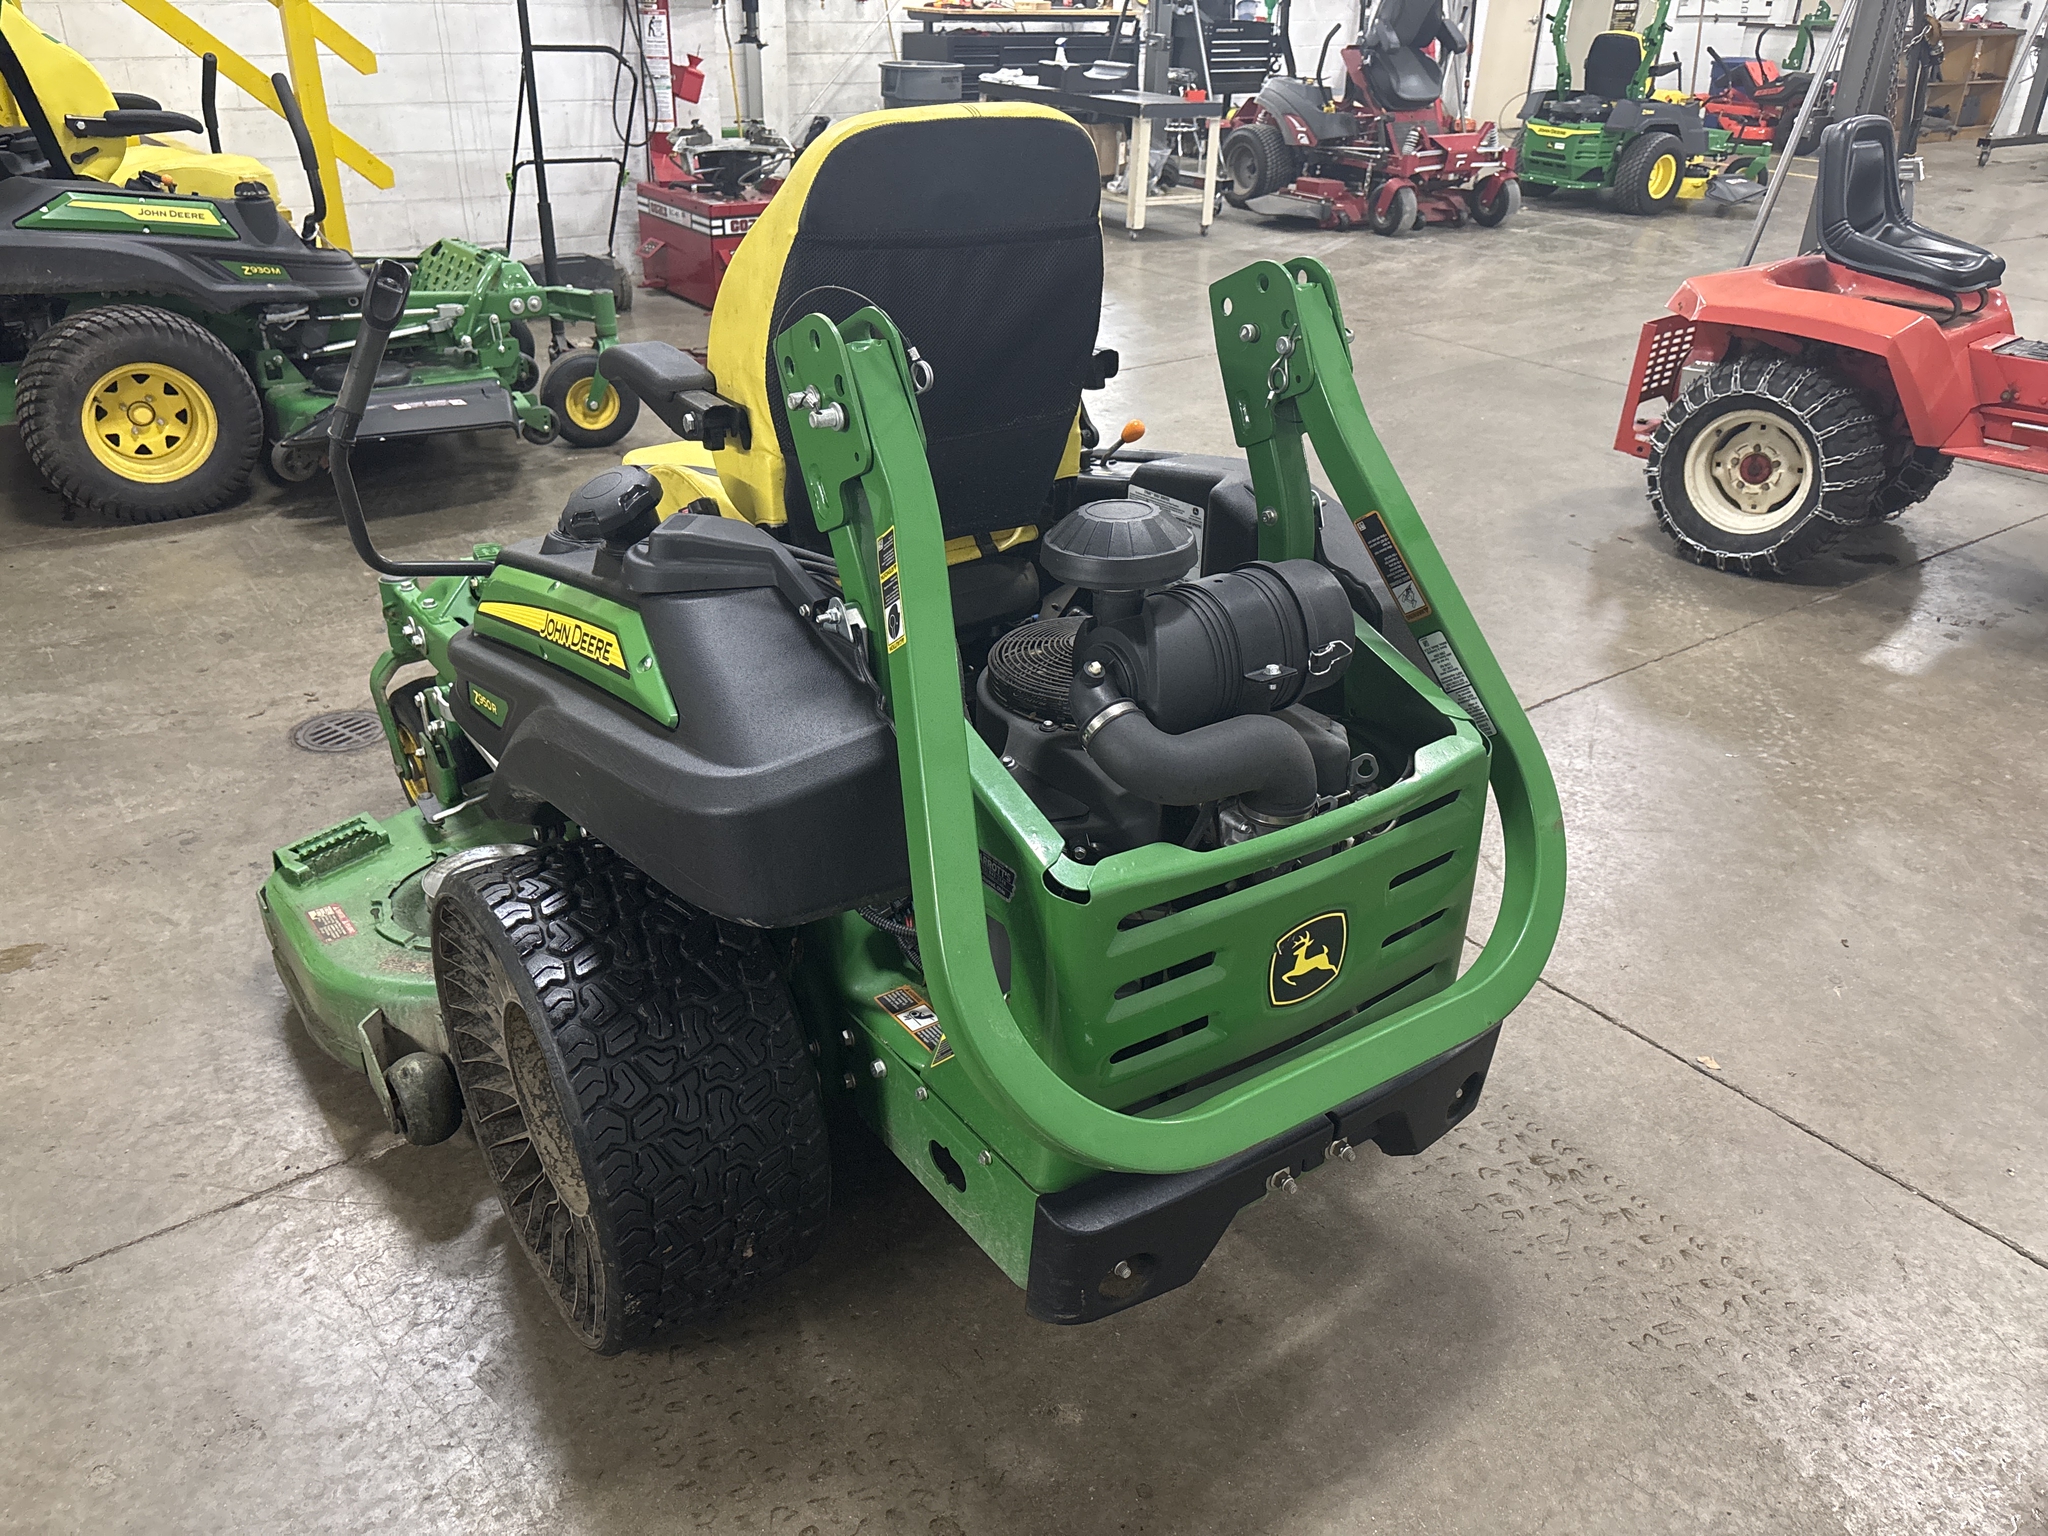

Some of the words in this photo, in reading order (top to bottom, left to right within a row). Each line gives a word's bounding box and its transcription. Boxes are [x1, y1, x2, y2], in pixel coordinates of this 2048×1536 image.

[138, 208, 167, 217] JOHN
[169, 210, 206, 220] DEERE
[241, 265, 282, 276] Z930M
[540, 613, 571, 644] JOHN
[571, 624, 613, 662] DEERE
